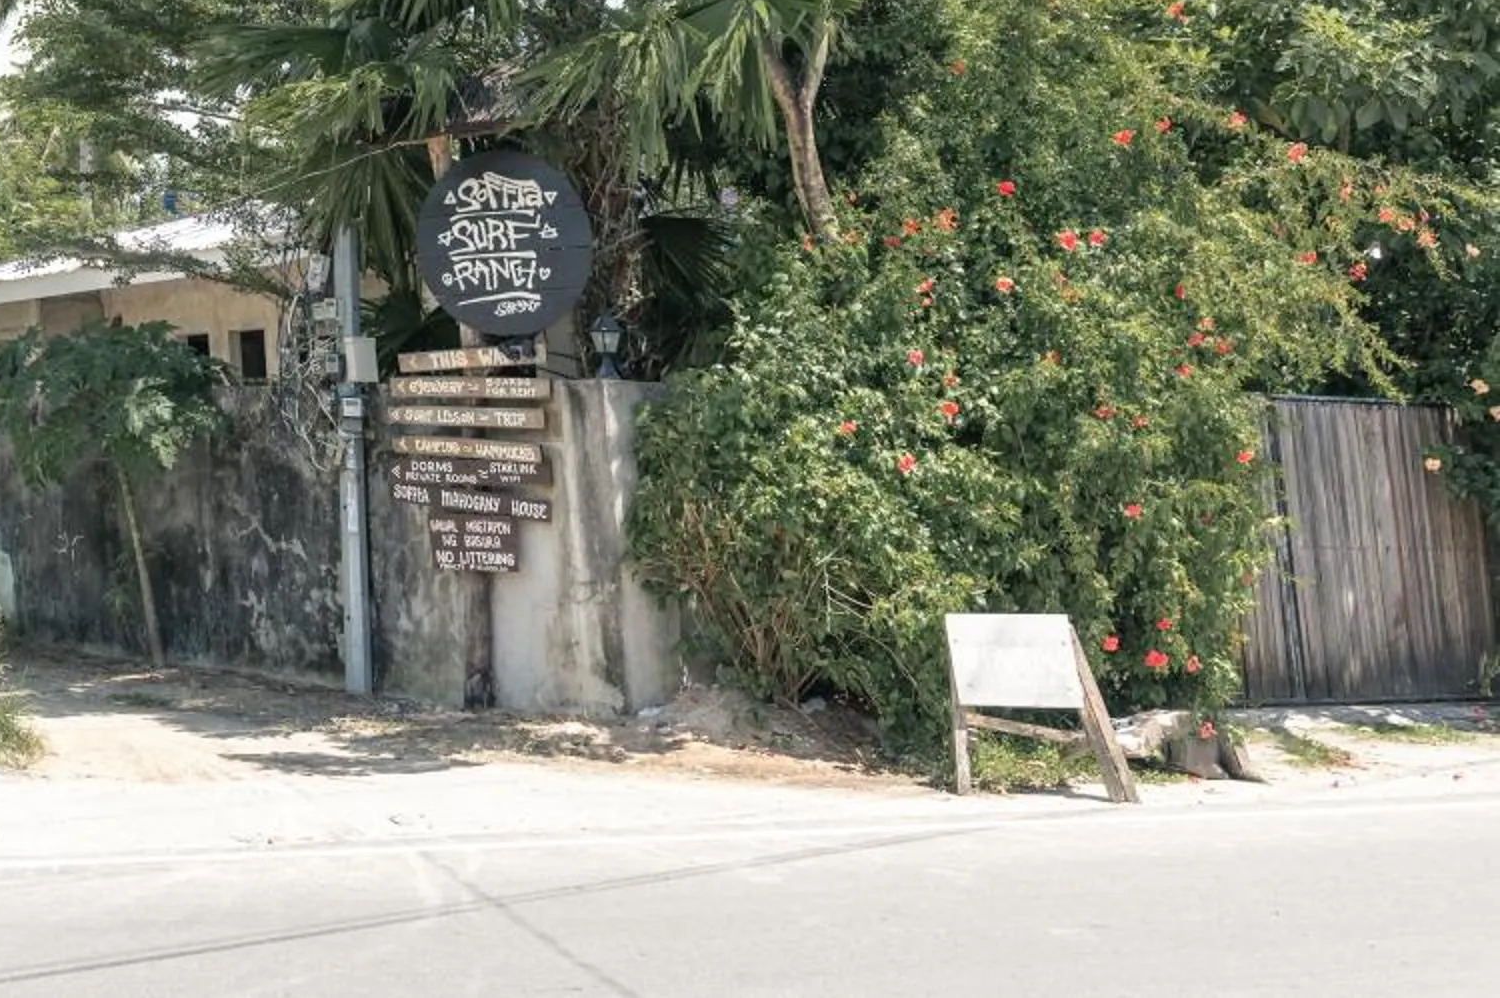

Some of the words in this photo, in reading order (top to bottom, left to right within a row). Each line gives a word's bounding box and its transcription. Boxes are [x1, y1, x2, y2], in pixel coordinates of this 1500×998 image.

[449, 214, 541, 254] SURF
[454, 257, 536, 291] RANCH
[429, 350, 468, 369] THIS
[493, 411, 526, 427] TRIP
[411, 460, 453, 473] DORMS
[405, 471, 441, 483] PRIVATE
[445, 473, 477, 485] ROOMS
[511, 499, 548, 520] HOUSE
[436, 549, 455, 564] NO
[459, 551, 516, 567] LITTERING
